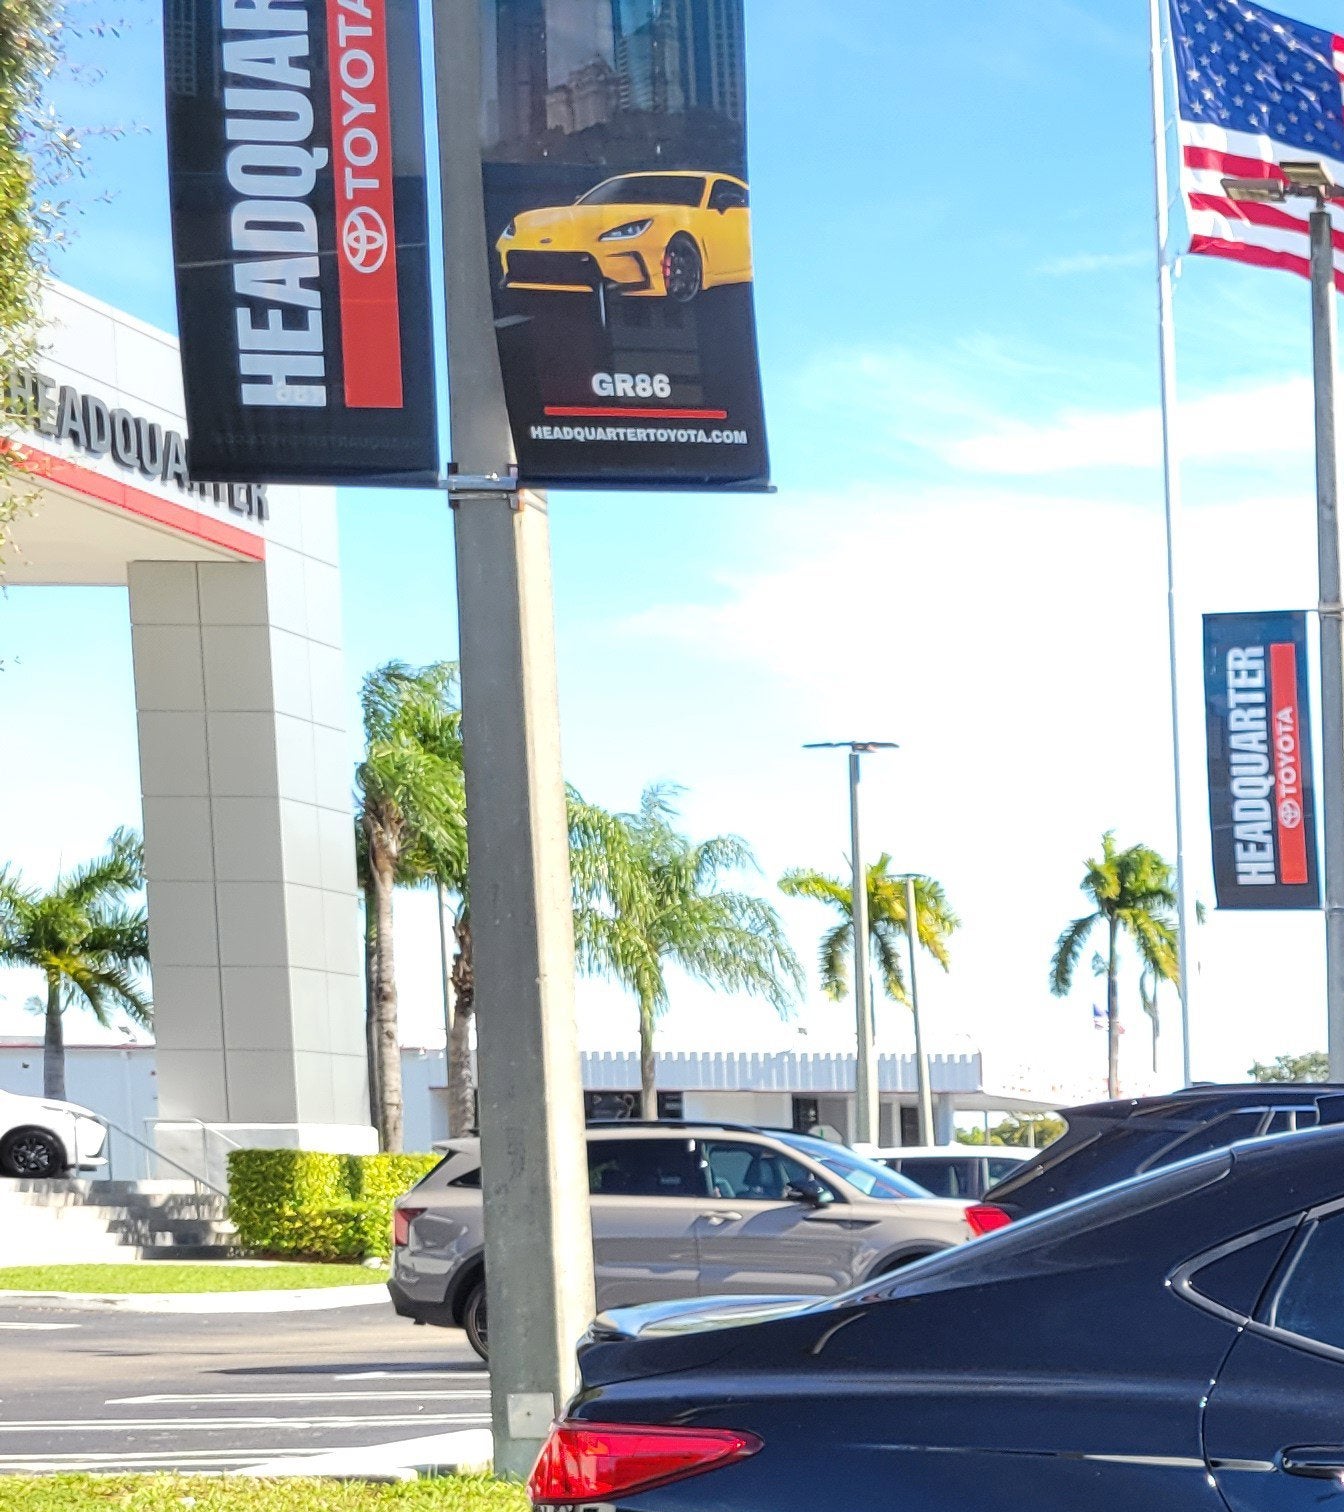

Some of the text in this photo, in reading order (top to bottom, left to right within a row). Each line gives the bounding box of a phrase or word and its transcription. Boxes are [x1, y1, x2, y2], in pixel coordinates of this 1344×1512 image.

[591, 372, 671, 399] GR86
[530, 425, 749, 445] HEADQUARTERTOYOTA.COM
[1226, 645, 1277, 885] HEADQUARTER
[1275, 705, 1297, 799] TOYOTA
